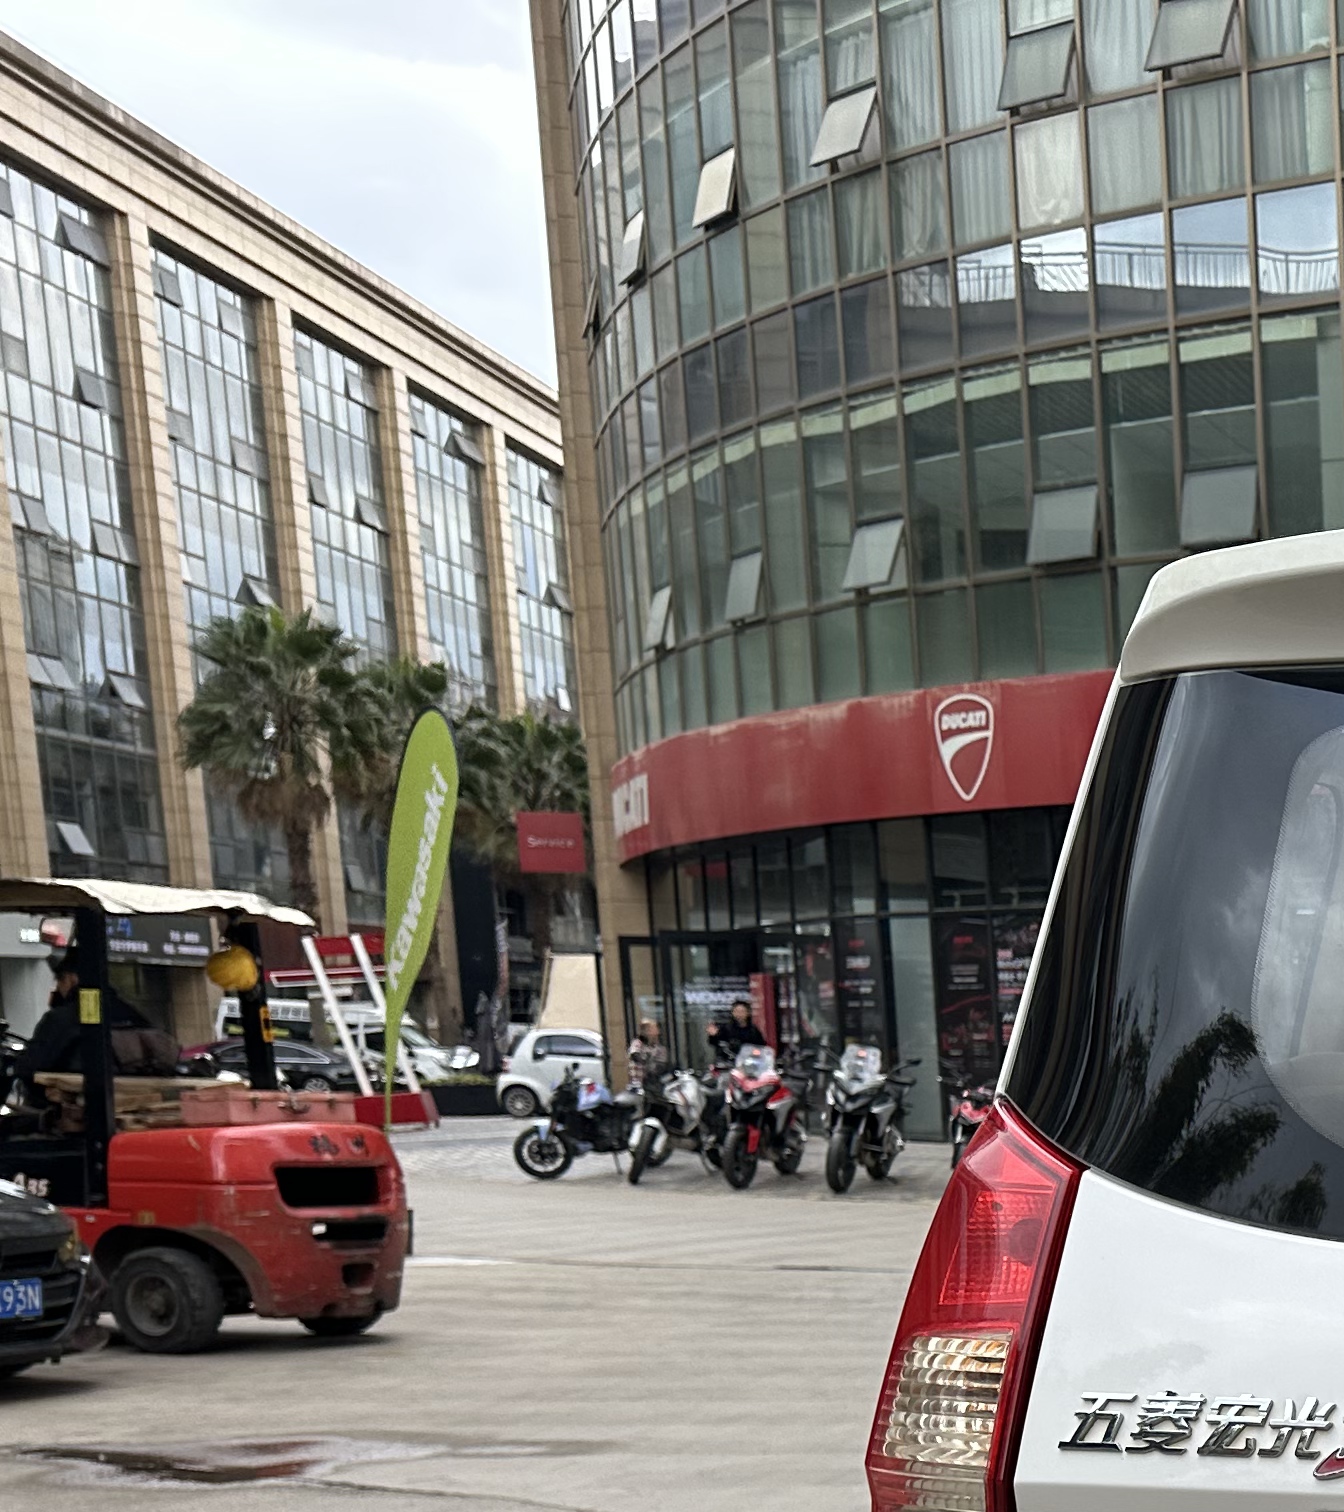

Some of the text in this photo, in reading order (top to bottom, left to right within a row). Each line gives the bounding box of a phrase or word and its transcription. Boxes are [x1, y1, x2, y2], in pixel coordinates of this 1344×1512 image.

[941, 710, 987, 731] DUCATI
[612, 773, 649, 838] CATI
[527, 834, 576, 849] Service
[388, 763, 448, 991] Kawasaki
[0, 1284, 40, 1313] 93N
